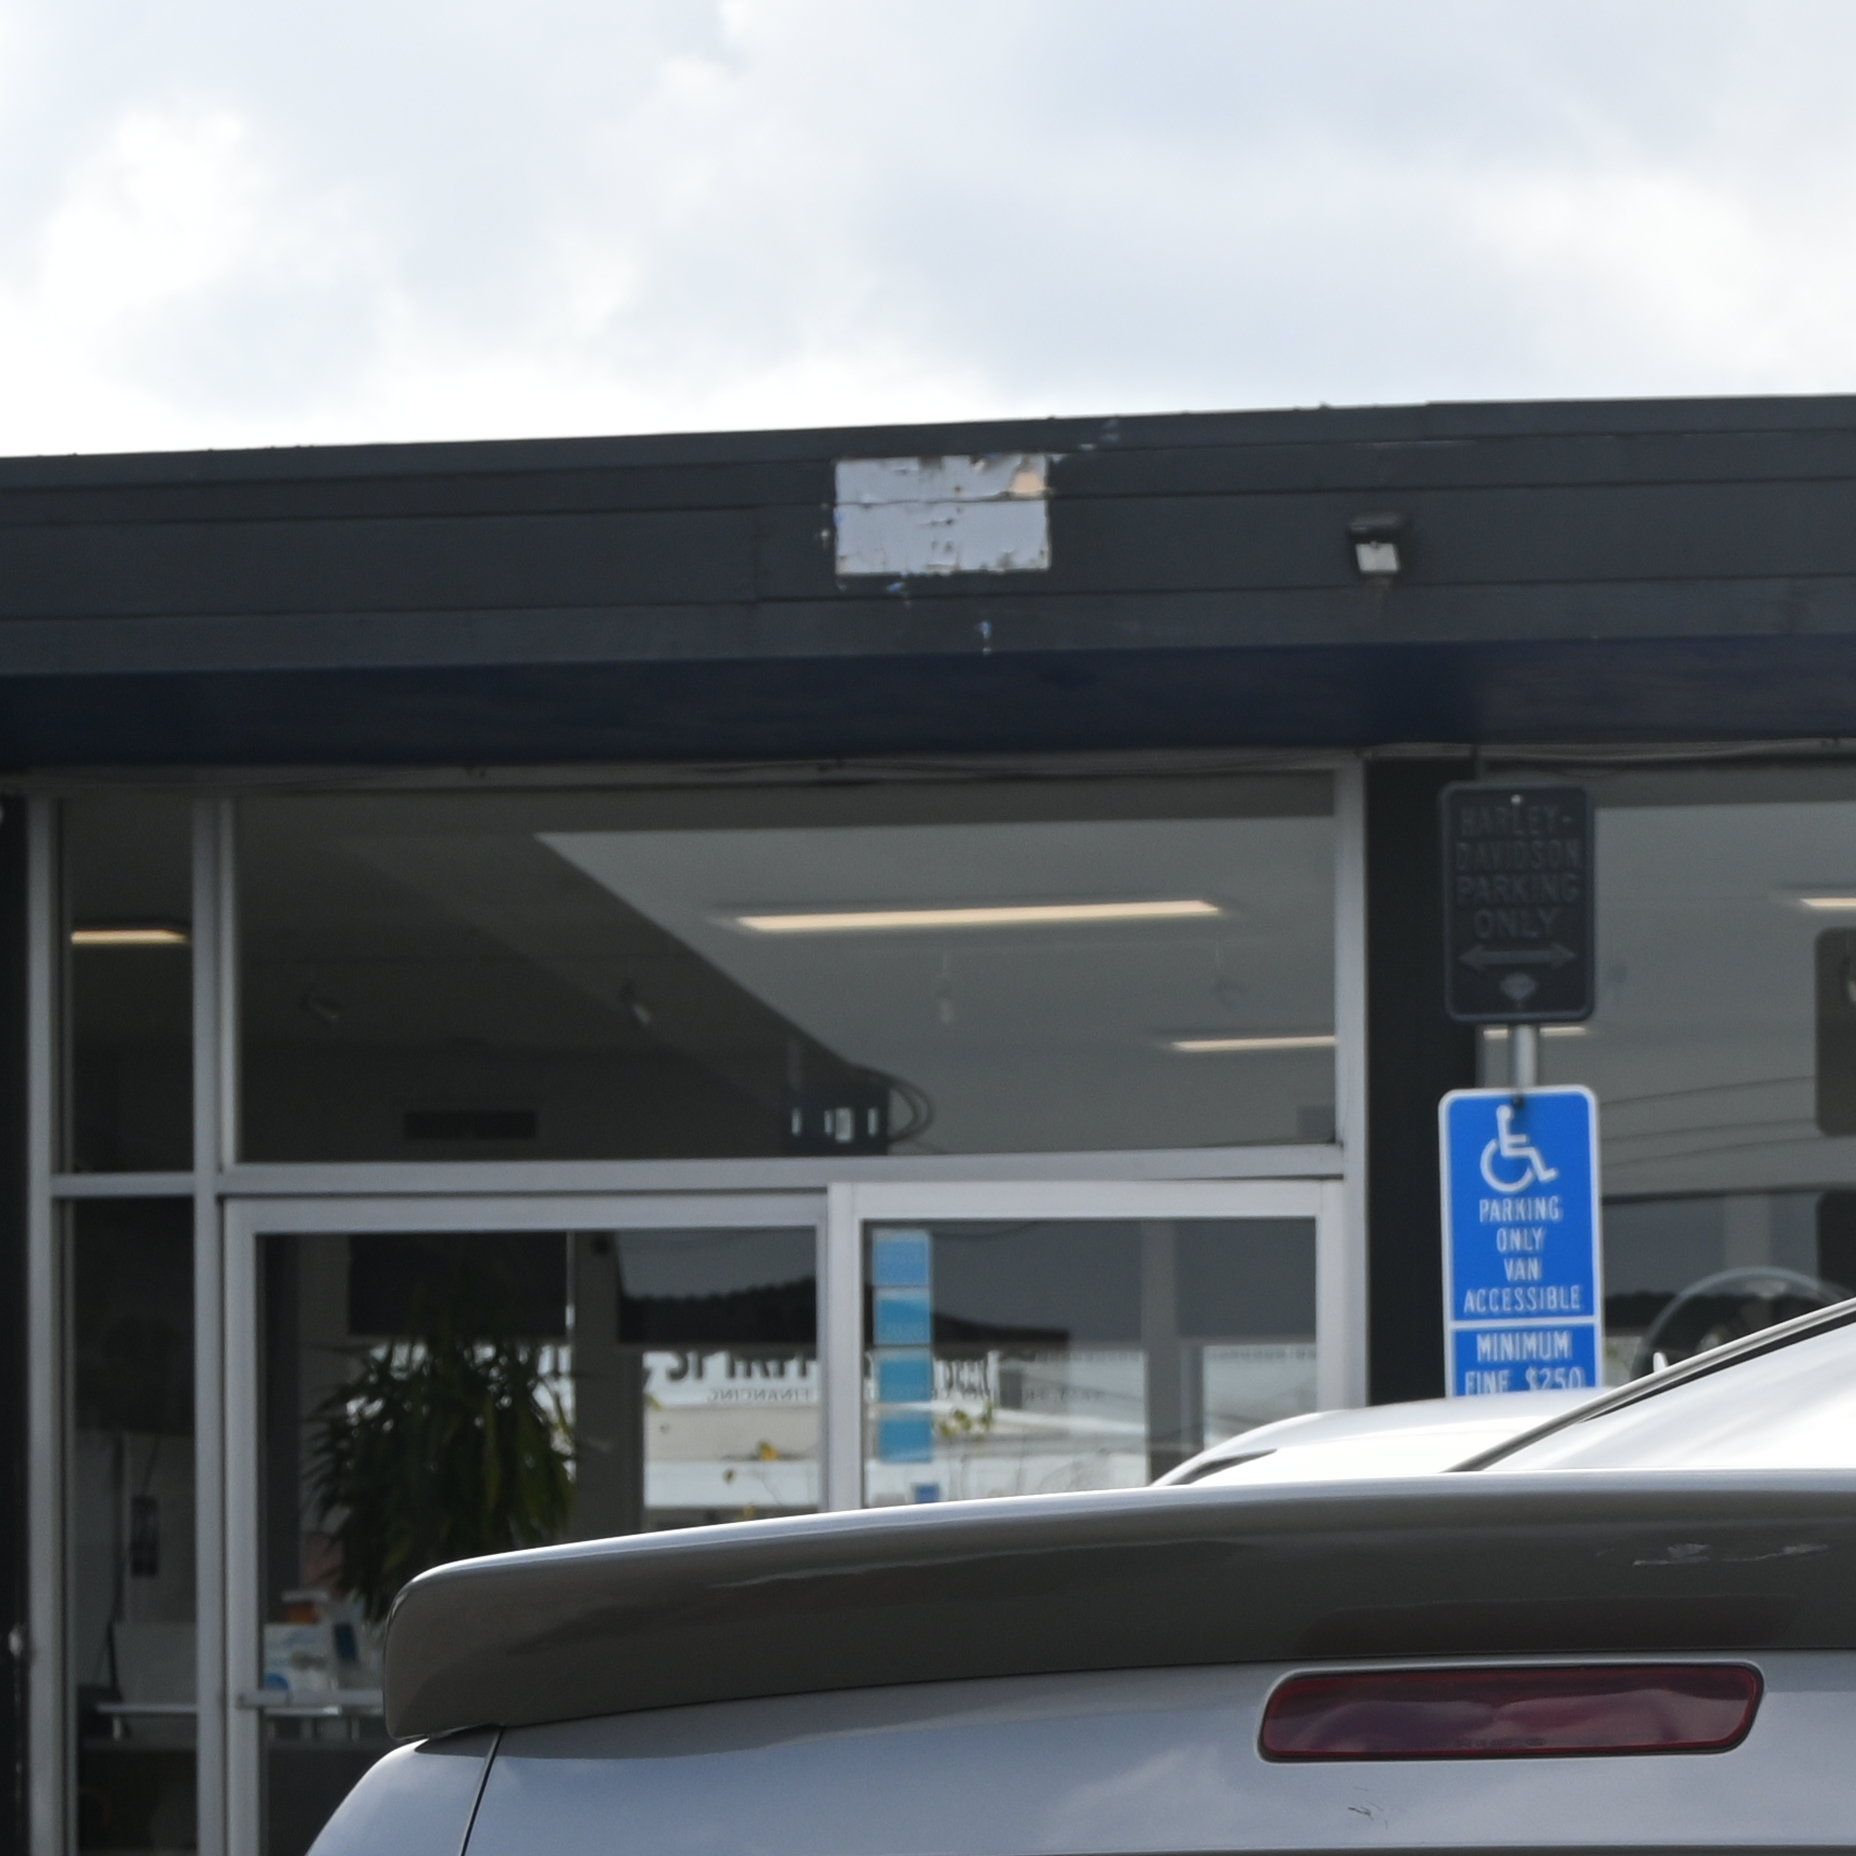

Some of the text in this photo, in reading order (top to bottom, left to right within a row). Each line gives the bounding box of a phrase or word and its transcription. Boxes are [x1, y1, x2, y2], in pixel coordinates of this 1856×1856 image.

[1456, 874, 1581, 904] PARKING
[1473, 909, 1557, 940] ONLY
[1479, 1196, 1562, 1223] PARKING
[1496, 1227, 1545, 1253] ONLY
[1503, 1257, 1542, 1282] VAN
[1463, 1284, 1581, 1314] ACCESSIBLE
[1476, 1330, 1573, 1362] MINIMUM
[1464, 1365, 1585, 1396] FINE $250
